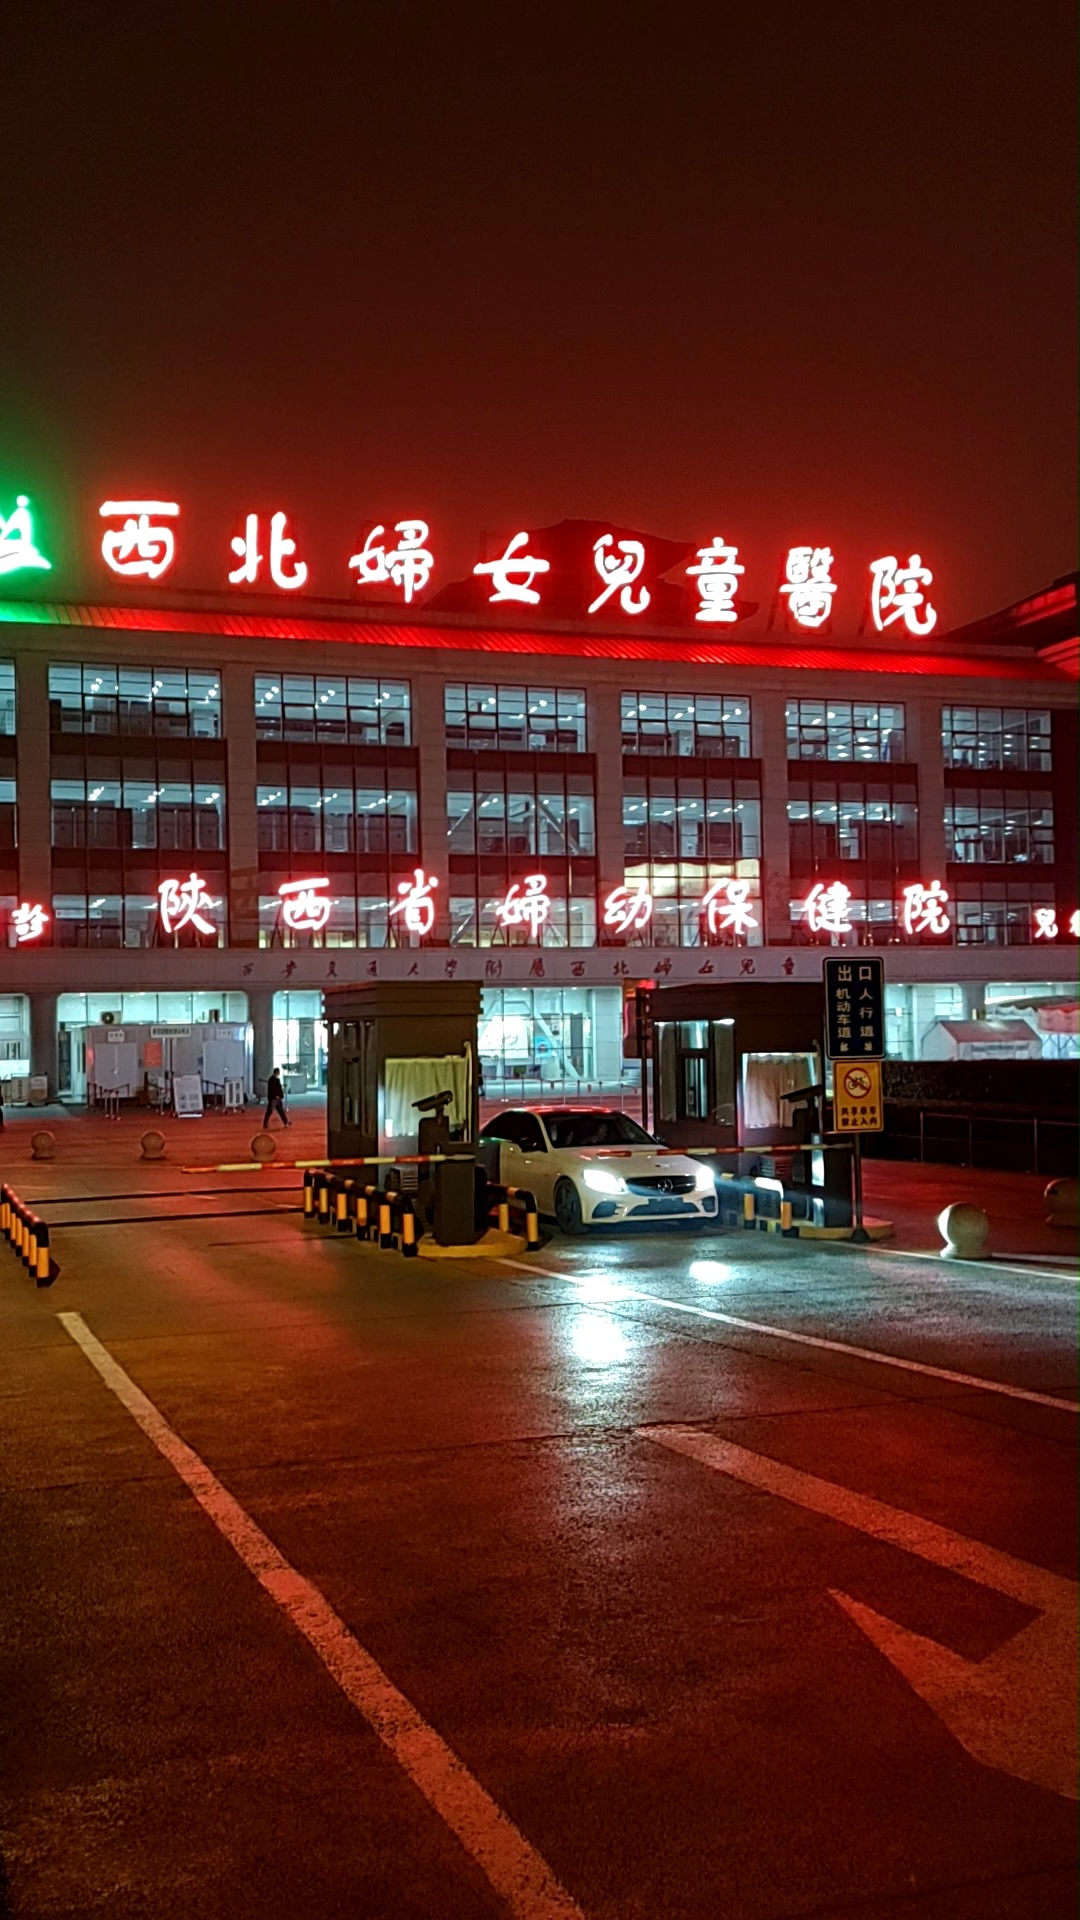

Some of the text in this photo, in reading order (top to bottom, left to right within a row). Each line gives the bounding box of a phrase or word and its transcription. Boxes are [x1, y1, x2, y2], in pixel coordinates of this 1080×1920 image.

[100, 500, 937, 636] 西北婦女兒童醫院
[838, 965, 872, 982] 出口
[837, 988, 851, 1038] 机动车道
[860, 988, 874, 1037] 人行道
